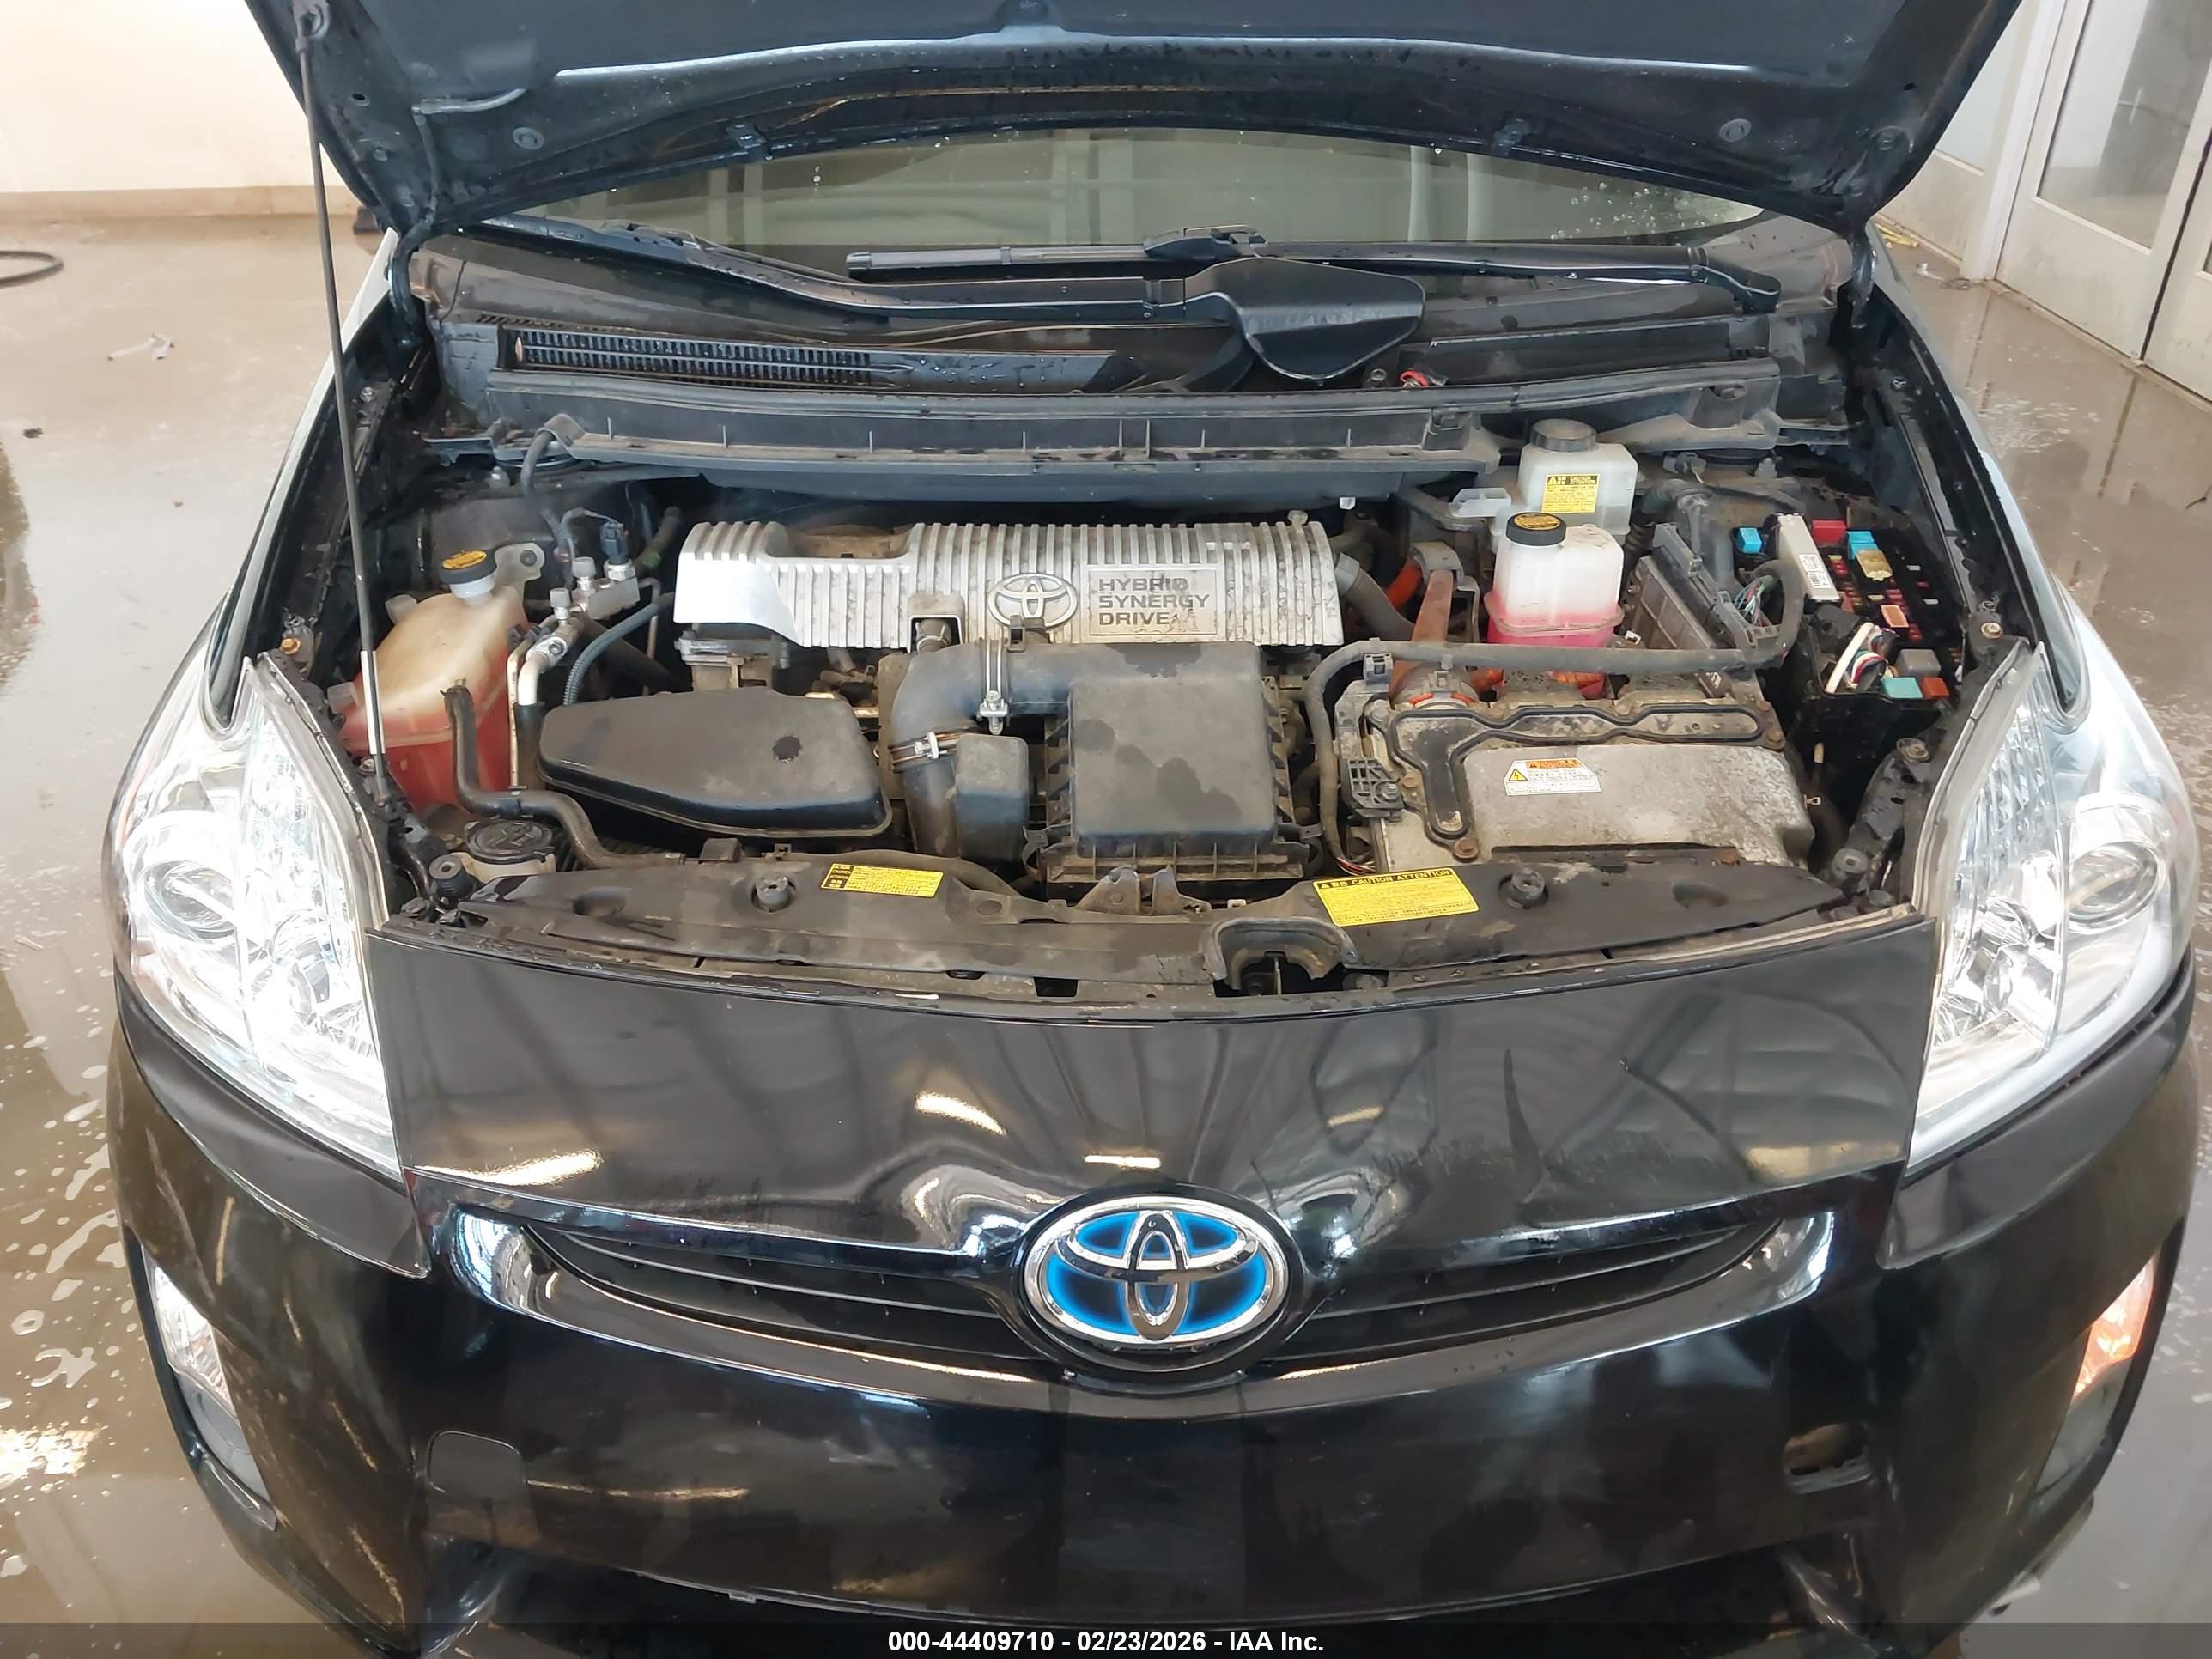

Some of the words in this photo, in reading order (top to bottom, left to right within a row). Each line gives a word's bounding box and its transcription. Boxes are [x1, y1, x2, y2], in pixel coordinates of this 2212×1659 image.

[1098, 578, 1189, 592] HYBRID
[1098, 594, 1210, 609] SYNERGY
[1098, 611, 1170, 626] DRIVE
[1352, 875, 1393, 886] CAUTION
[1396, 869, 1450, 882] ATTENTION
